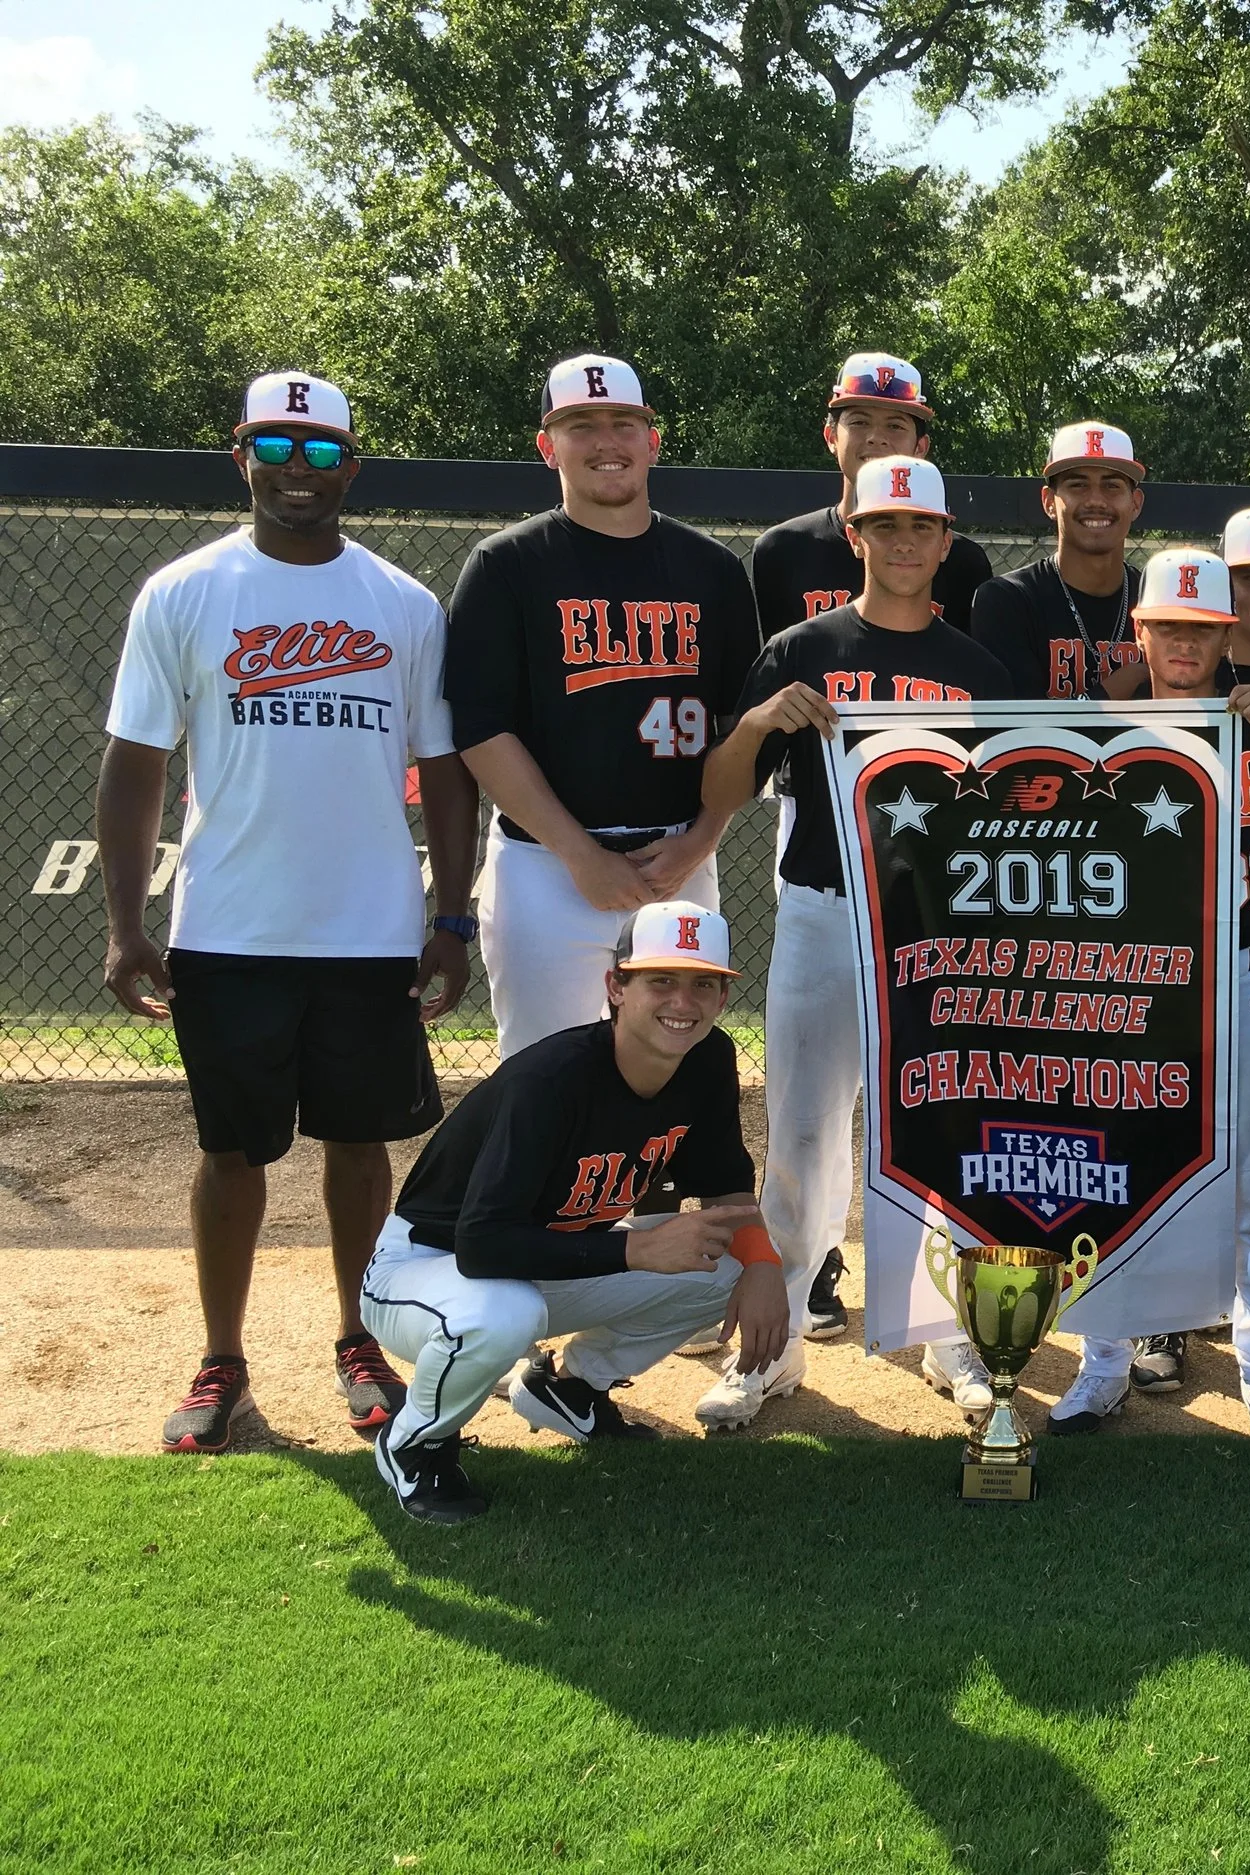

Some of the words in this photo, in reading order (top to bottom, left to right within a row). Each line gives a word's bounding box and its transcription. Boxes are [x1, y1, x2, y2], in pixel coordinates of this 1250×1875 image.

[286, 382, 309, 414] E
[584, 366, 608, 398] E
[1085, 430, 1105, 457] E
[891, 467, 911, 498] E
[1177, 565, 1199, 599] E
[557, 599, 700, 665] ELITE
[224, 620, 392, 682] Elite
[288, 690, 338, 700] ACADEMY
[231, 700, 390, 733] BASEBALL
[637, 697, 708, 758] 49
[1000, 775, 1063, 811] NB
[968, 820, 1099, 838] BASEBALL
[946, 849, 1129, 919] 2019
[676, 915, 701, 950] E
[894, 938, 1017, 987] TEXAS
[1022, 940, 1194, 985] PREMIER
[929, 987, 1153, 1035] CHALLENGE
[900, 1050, 1191, 1110] CHAMPIONS
[1000, 1131, 1089, 1160] TEXAS
[961, 1152, 1129, 1205] PREMIER
